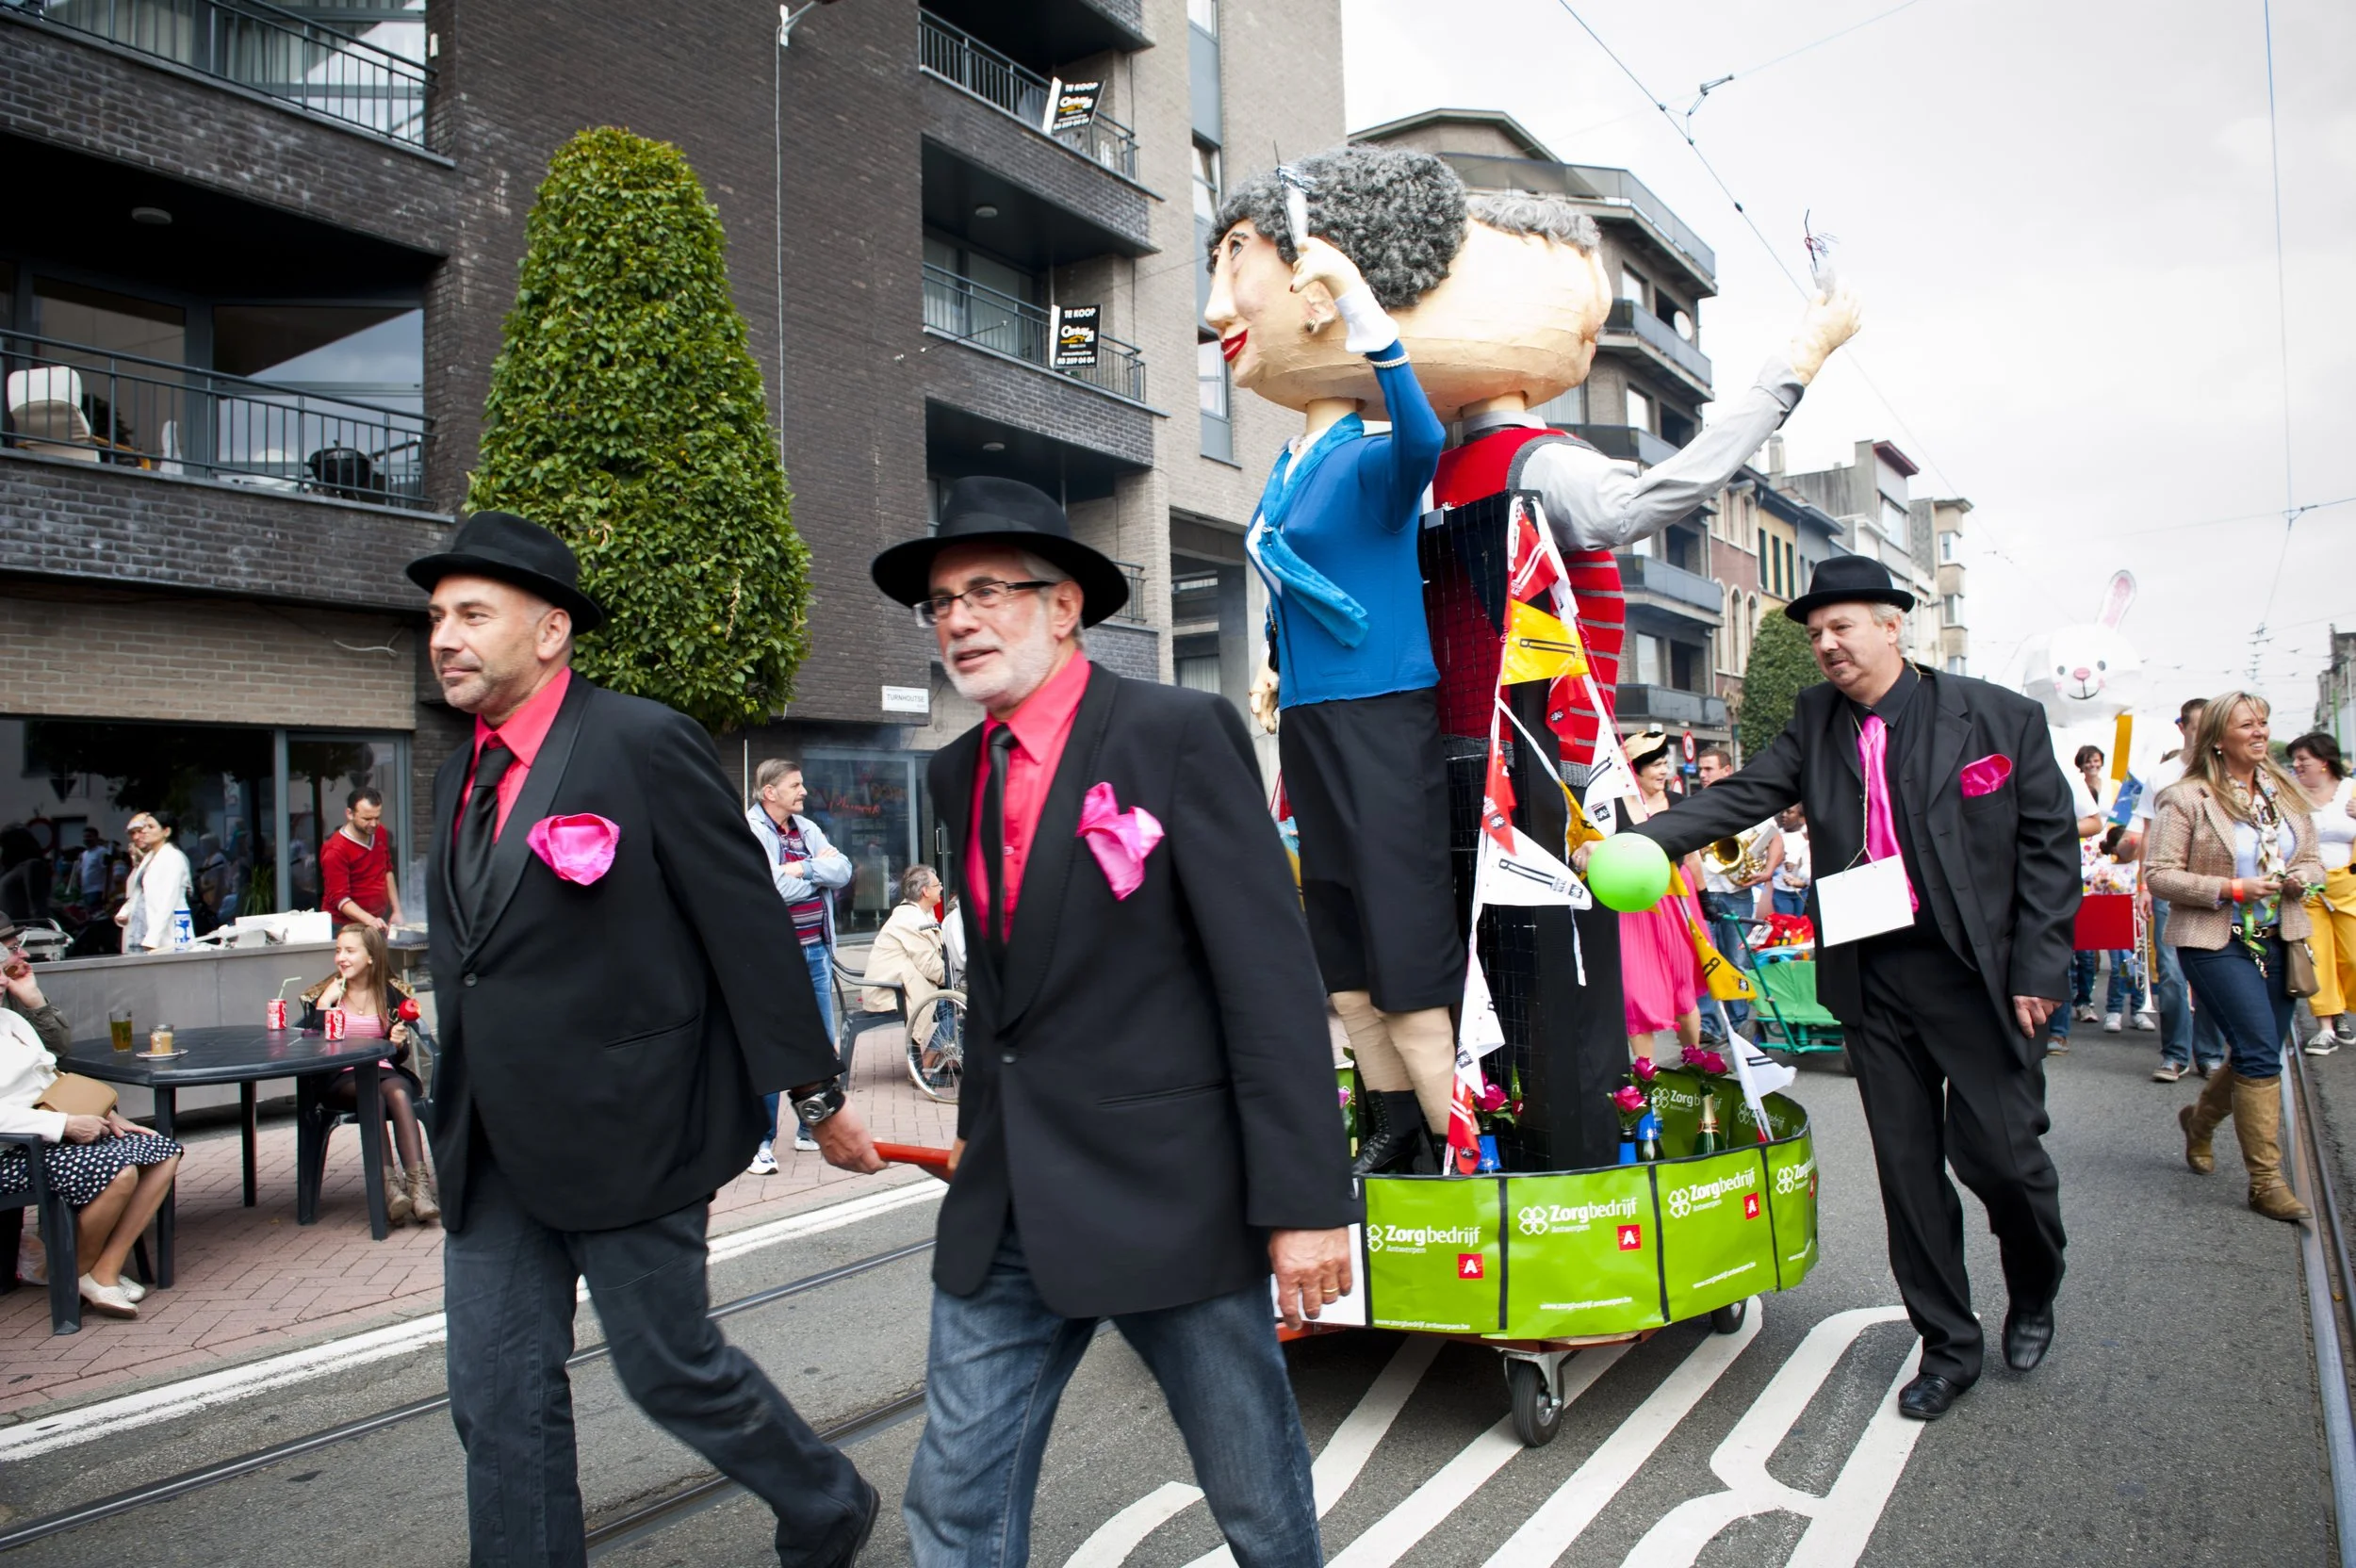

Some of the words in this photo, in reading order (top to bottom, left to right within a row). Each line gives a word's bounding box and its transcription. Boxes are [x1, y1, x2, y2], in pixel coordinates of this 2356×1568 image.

[1074, 82, 1099, 92] KOOP
[1064, 309, 1072, 318] TE
[1073, 307, 1096, 318] KOOP
[887, 694, 925, 703] TURNHOUTSE
[1689, 1168, 1756, 1203] Zorgbedrijf
[1548, 1197, 1638, 1224] Zorgbedrijf
[1747, 1199, 1758, 1215] A
[1384, 1225, 1481, 1248] Zorgbedrijf
[1622, 1230, 1637, 1246] A
[1385, 1245, 1427, 1255] Antwerpen
[1463, 1258, 1479, 1274] A
